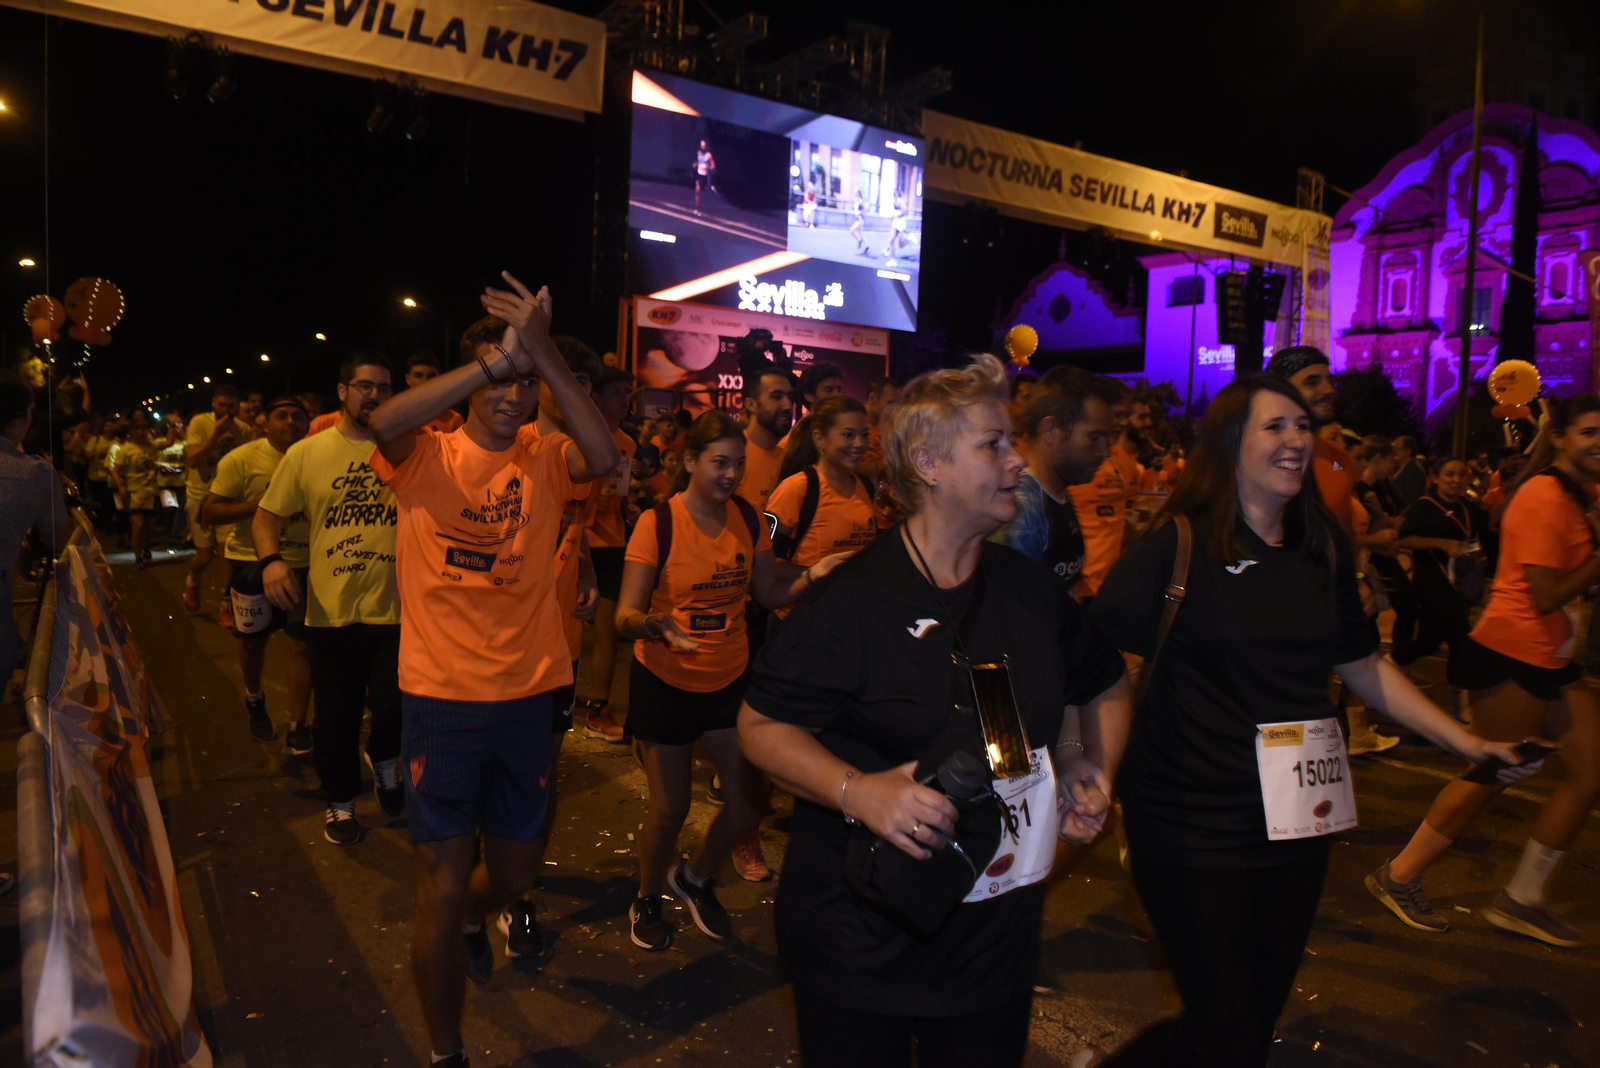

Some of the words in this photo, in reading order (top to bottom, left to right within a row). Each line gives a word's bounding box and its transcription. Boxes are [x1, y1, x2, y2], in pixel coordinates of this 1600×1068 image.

[928, 138, 1063, 192] NOCTURNA
[1069, 174, 1155, 216] SEVILLA
[343, 490, 381, 503] SON
[326, 533, 363, 559] BEATRIZ
[453, 551, 486, 565] Sevilla
[333, 563, 366, 577] CHARO
[711, 569, 748, 581] NOCTURNA
[691, 580, 729, 591] SEVILLA
[236, 605, 263, 618] 12764
[1292, 756, 1343, 788] 15022
